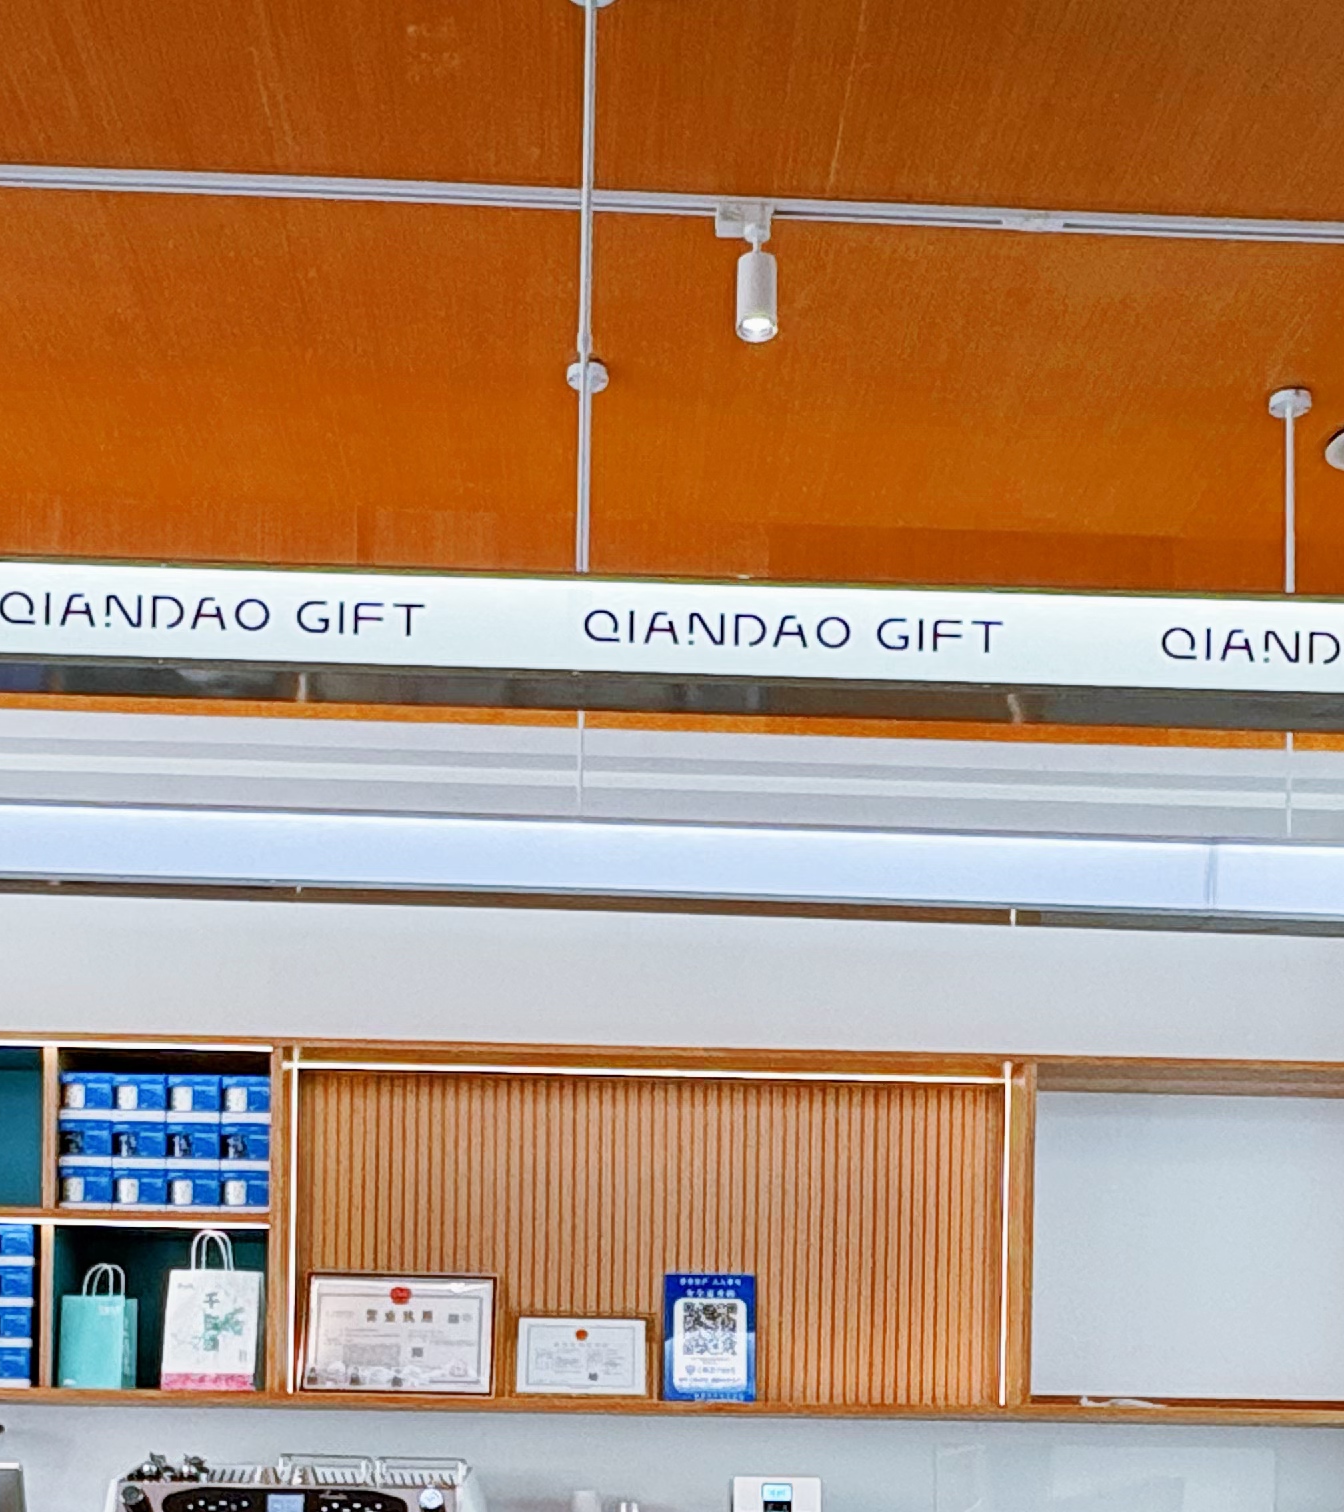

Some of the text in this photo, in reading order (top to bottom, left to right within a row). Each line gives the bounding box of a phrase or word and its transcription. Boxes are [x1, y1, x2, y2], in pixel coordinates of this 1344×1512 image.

[295, 600, 426, 637] GIFT
[583, 608, 1005, 653] QIANDAO GIFT
